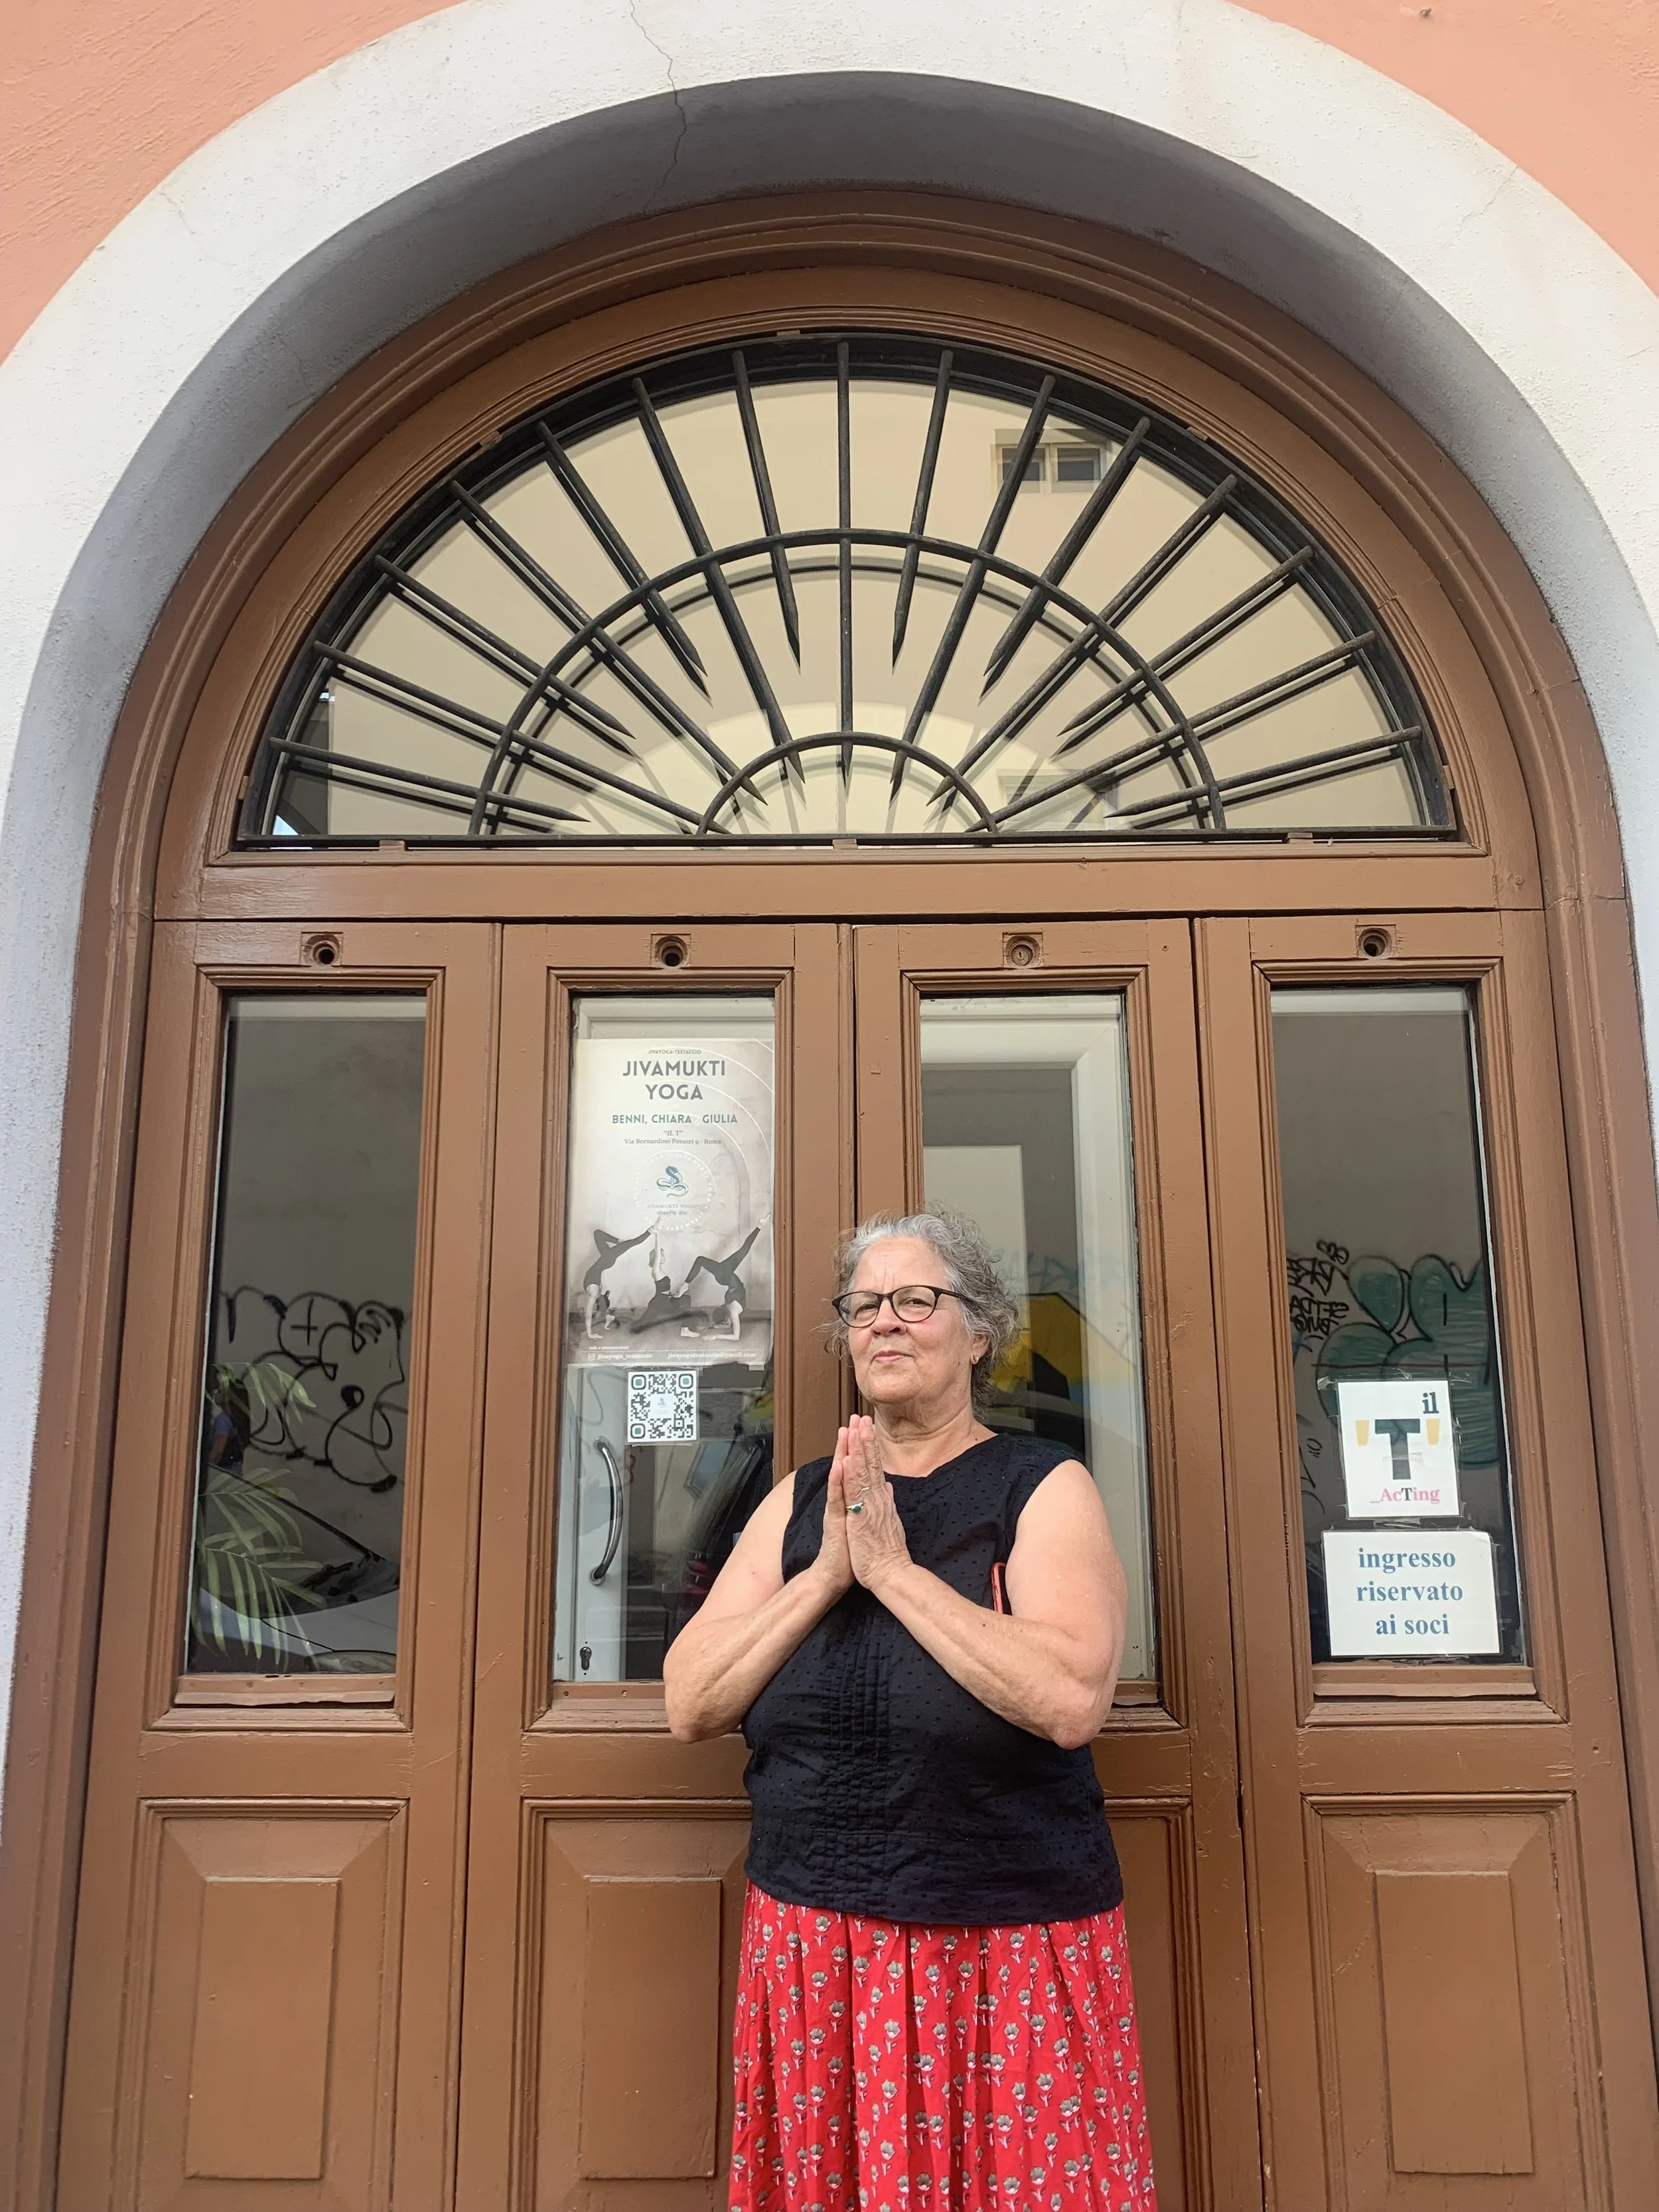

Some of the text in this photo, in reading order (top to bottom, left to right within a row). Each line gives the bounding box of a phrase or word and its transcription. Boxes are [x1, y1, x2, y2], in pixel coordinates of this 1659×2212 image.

[622, 1061, 725, 1076] JIVAMUKTI
[644, 1084, 703, 1100] YOGA
[612, 1114, 648, 1125] BENNI,
[651, 1114, 692, 1124] CHIARA
[702, 1114, 738, 1124] GIULIA
[1421, 1391, 1439, 1414] il
[1358, 1548, 1456, 1574] ingresso
[1356, 1581, 1463, 1601] riservato
[1376, 1613, 1449, 1635] ai soci
